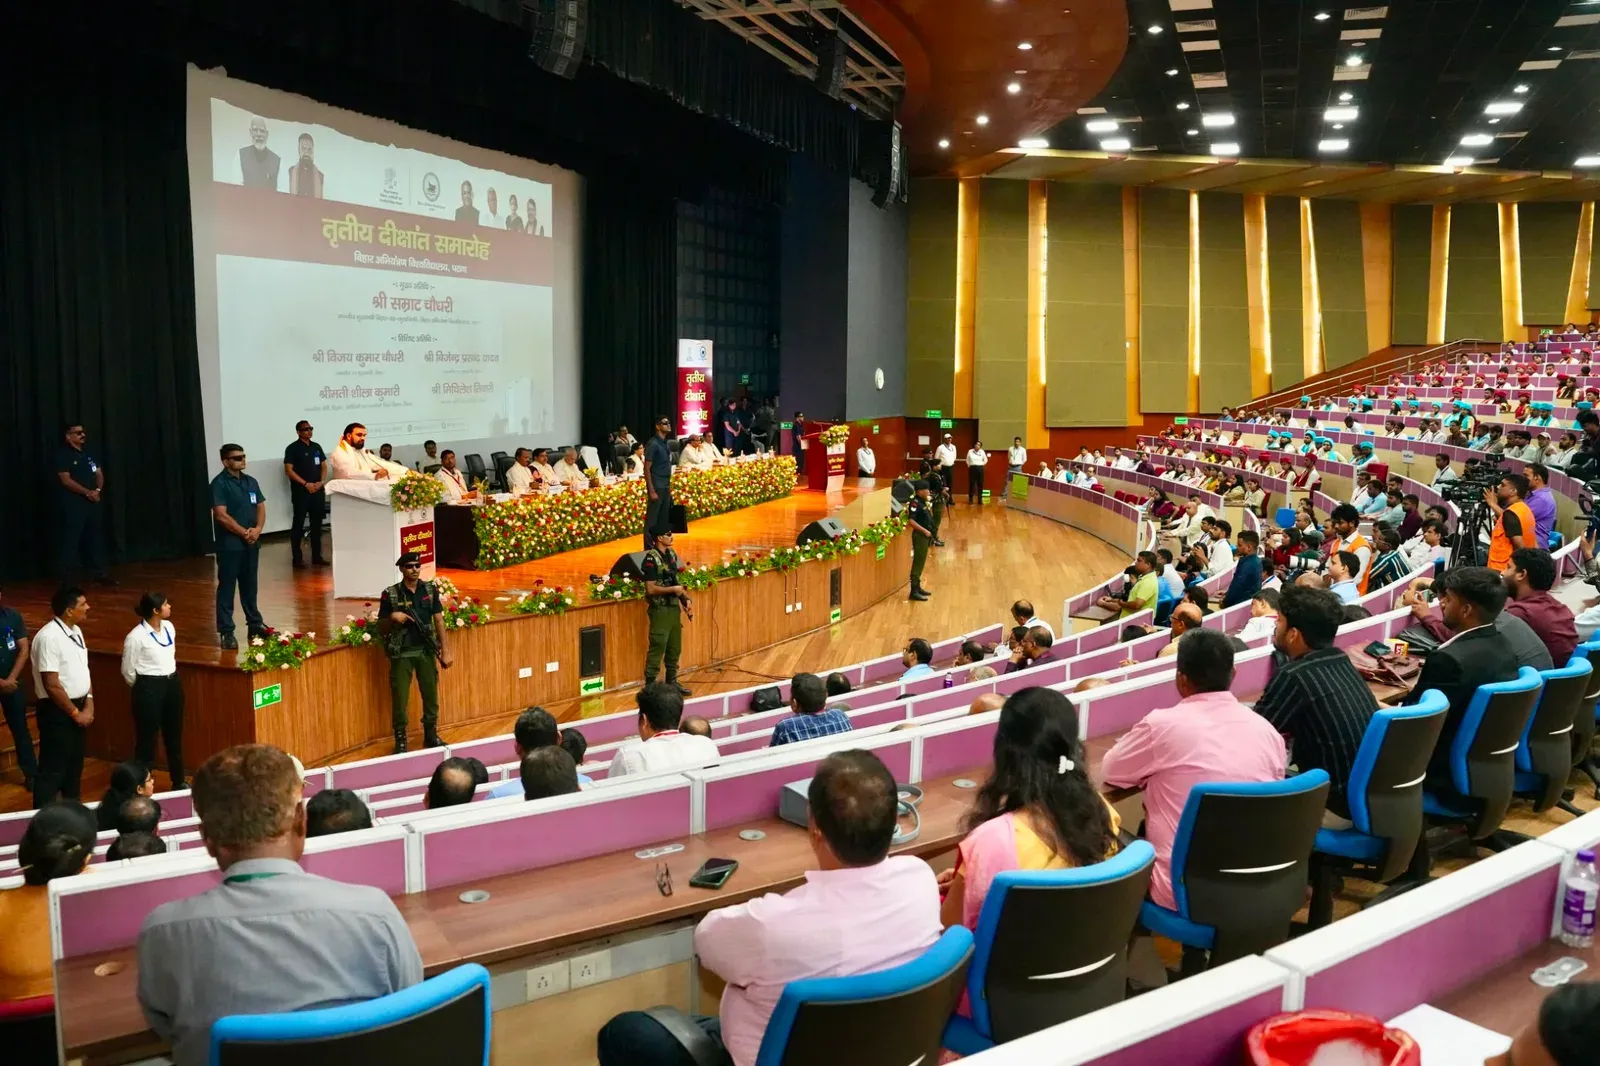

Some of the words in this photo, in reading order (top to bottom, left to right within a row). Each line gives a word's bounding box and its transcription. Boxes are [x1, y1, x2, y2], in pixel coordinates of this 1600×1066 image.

[321, 213, 374, 248] तृतीय
[378, 219, 431, 251] दीक्षांत
[434, 232, 491, 261] समारोह
[372, 290, 388, 310] श्री
[389, 296, 422, 312] सम्राट
[424, 295, 454, 313] चौधरी
[312, 349, 324, 363] श्री
[326, 349, 353, 363] विजय
[355, 352, 381, 368] कुमार
[381, 349, 405, 363] चौधरी
[424, 350, 434, 362] श्री
[685, 370, 705, 387] तृतीय
[318, 385, 349, 399] श्रीमती
[350, 384, 373, 398] शीला
[374, 383, 400, 401] कुमारी
[431, 382, 441, 395] श्री
